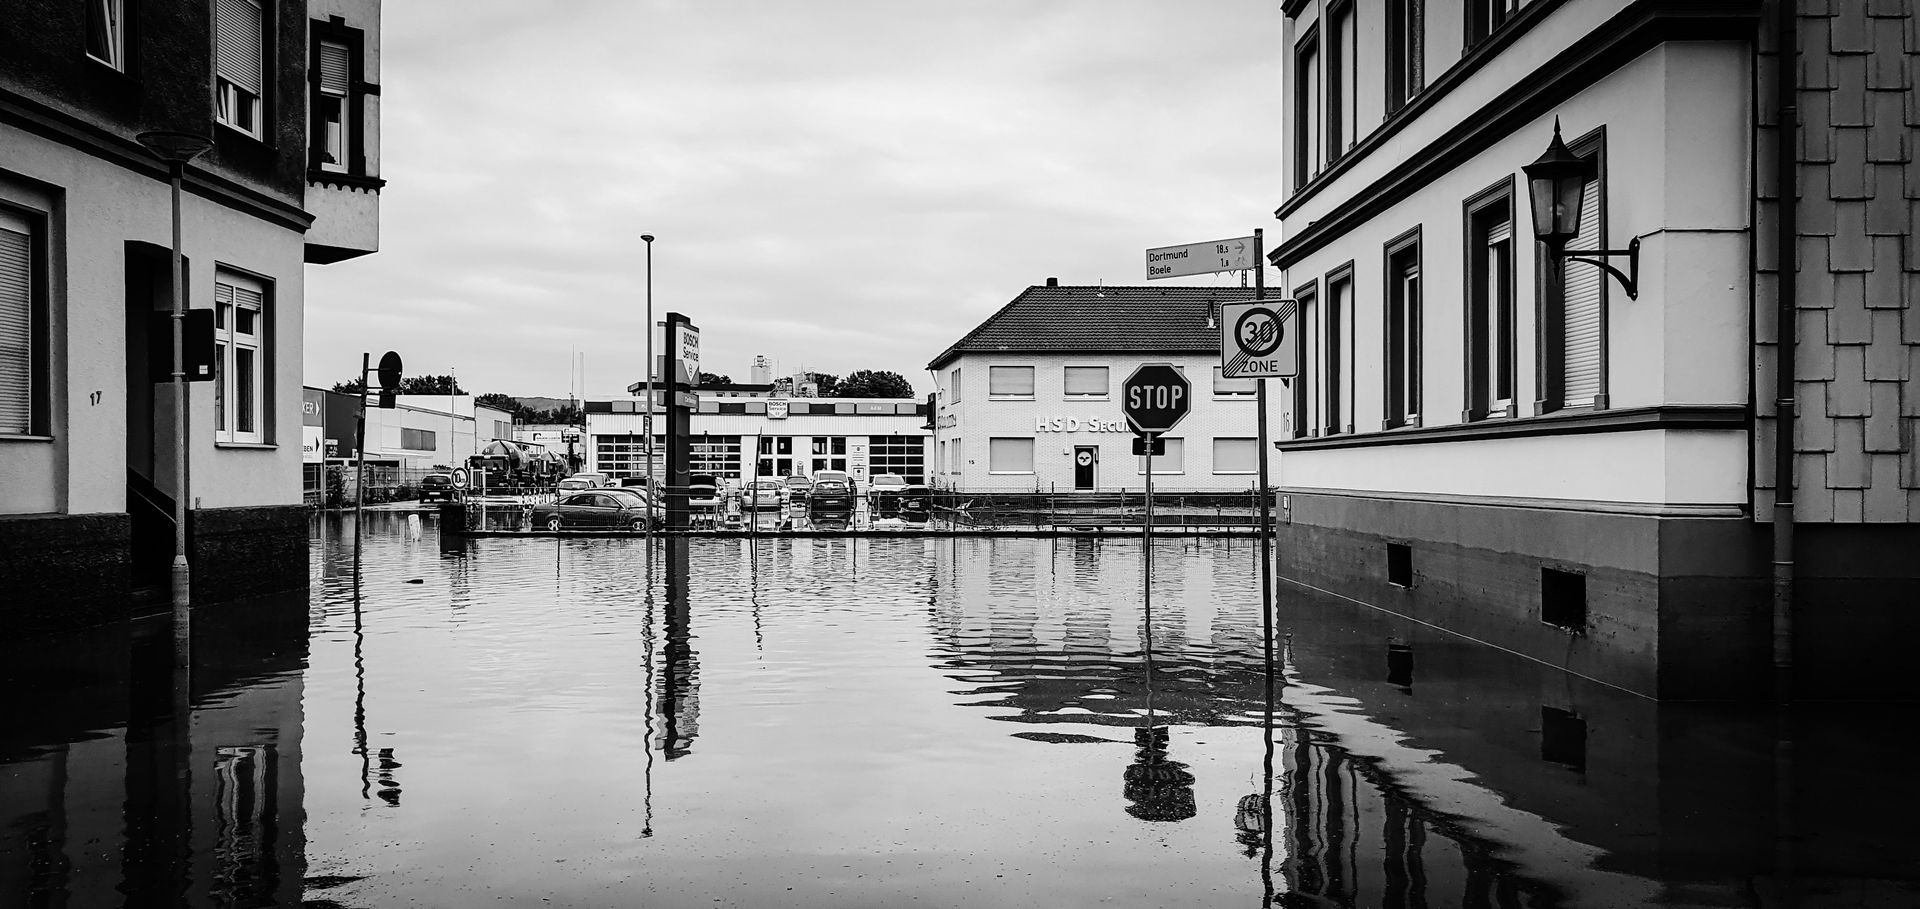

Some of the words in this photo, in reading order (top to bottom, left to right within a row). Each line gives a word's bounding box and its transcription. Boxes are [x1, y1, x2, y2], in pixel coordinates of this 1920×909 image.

[1149, 248, 1188, 262] Dortmund
[1149, 264, 1172, 275] Boele
[1244, 320, 1273, 343] 30
[683, 332, 698, 348] BOSCH
[683, 346, 699, 362] Service
[1241, 360, 1278, 373] ZONE
[90, 390, 102, 407] 17
[1130, 385, 1182, 409] STOP
[1035, 416, 1080, 433] HSD
[1282, 412, 1290, 433] 16
